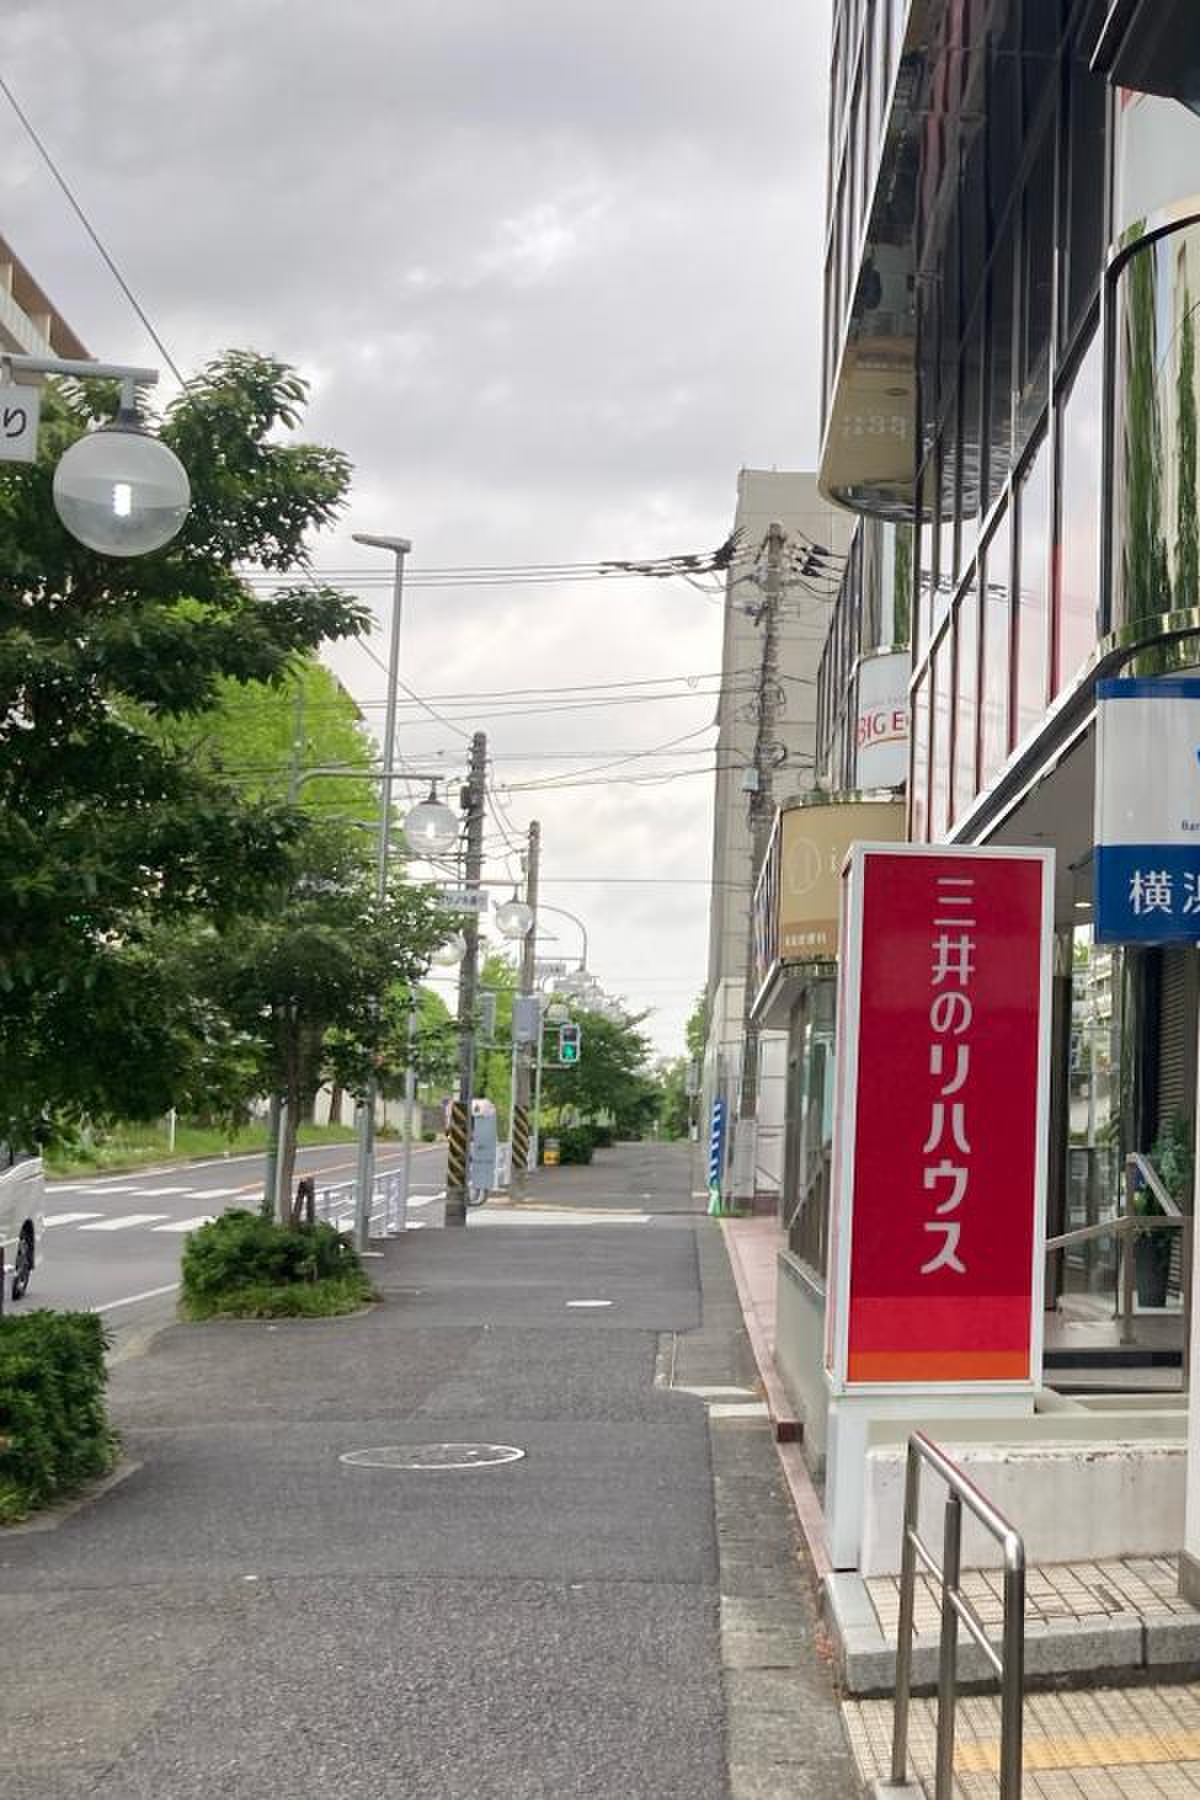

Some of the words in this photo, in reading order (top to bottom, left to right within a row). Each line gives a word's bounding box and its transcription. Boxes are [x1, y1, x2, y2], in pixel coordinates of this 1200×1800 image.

[3, 407, 27, 438] り
[920, 877, 977, 1275] 三井のリハウス
